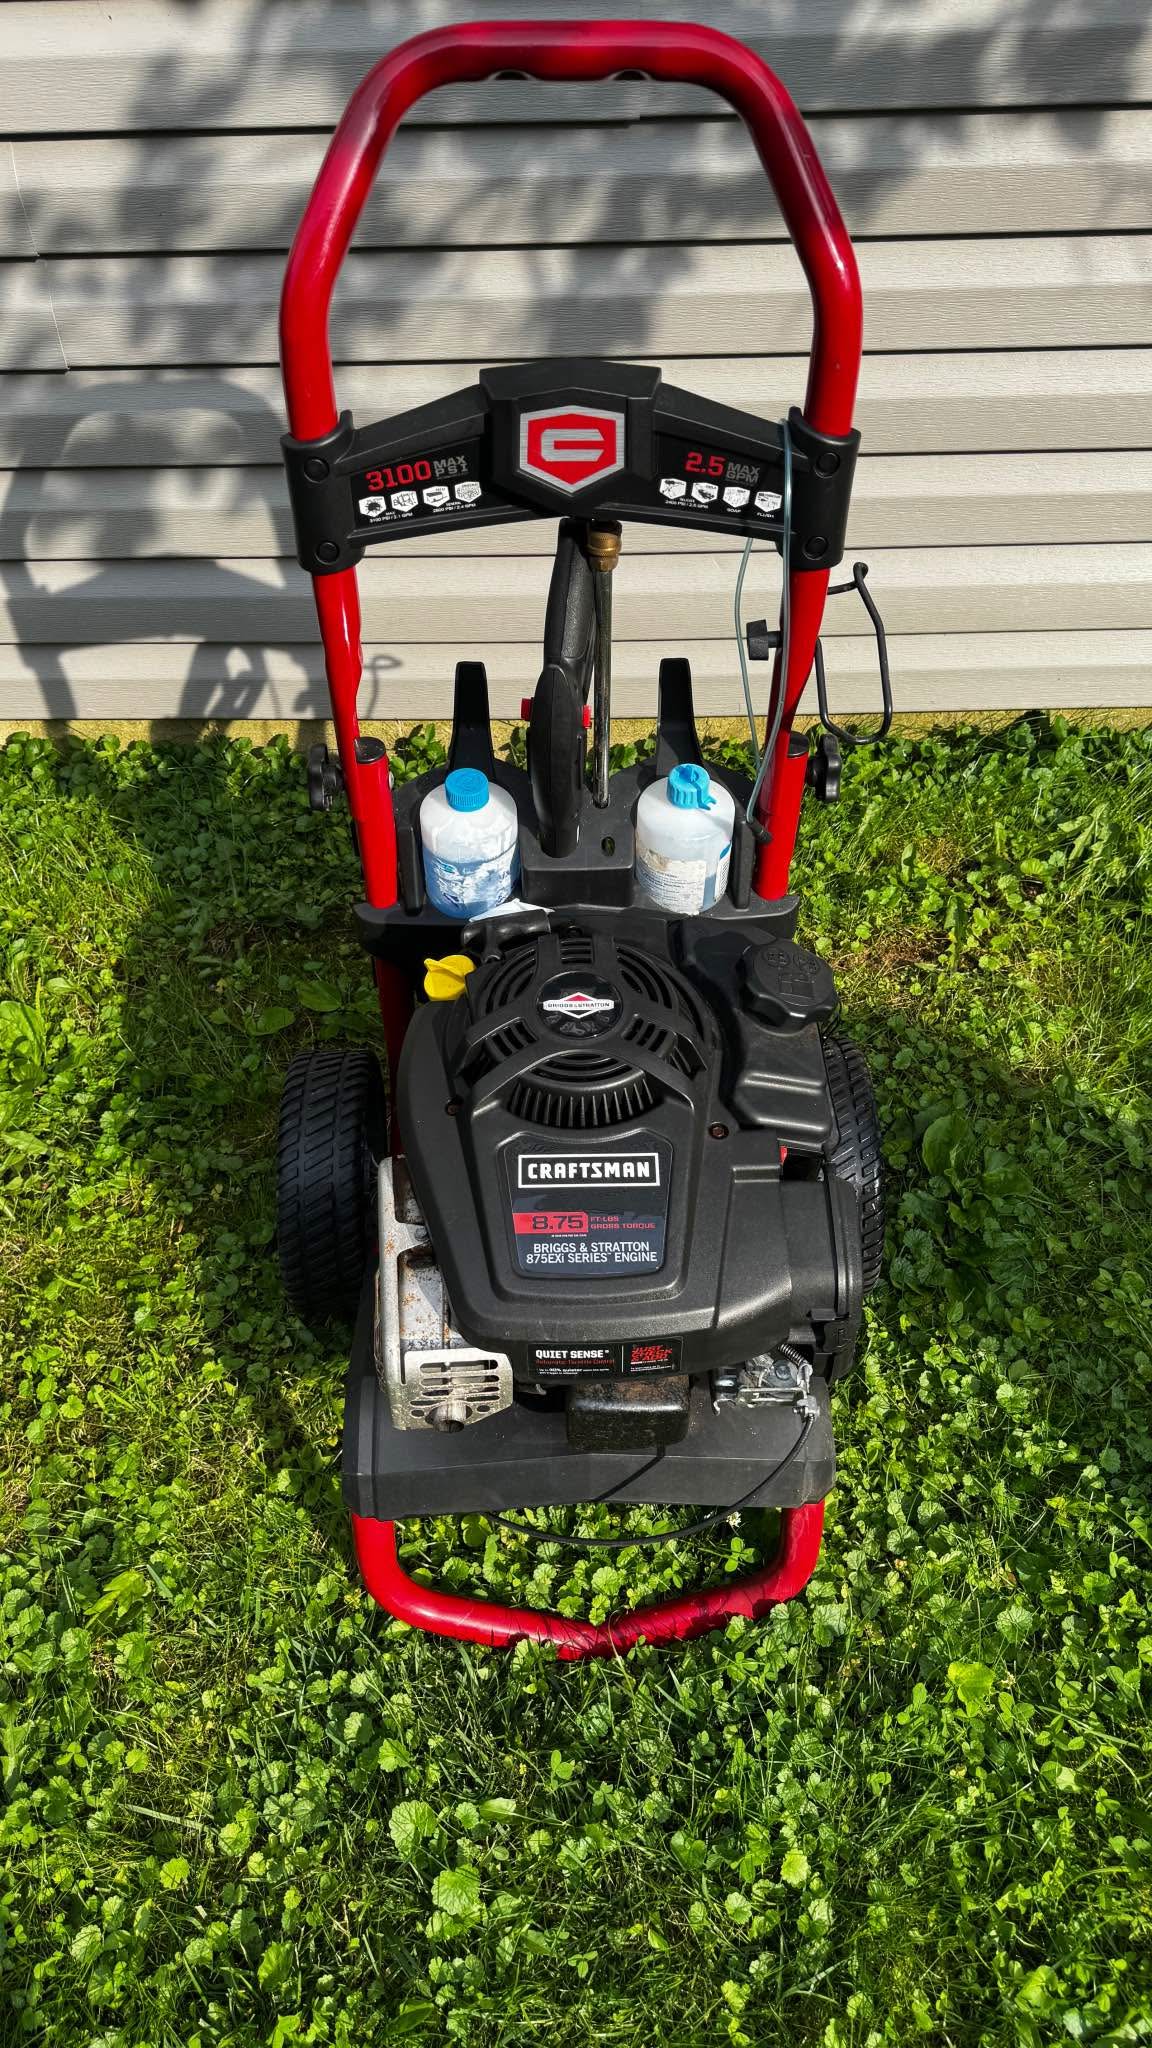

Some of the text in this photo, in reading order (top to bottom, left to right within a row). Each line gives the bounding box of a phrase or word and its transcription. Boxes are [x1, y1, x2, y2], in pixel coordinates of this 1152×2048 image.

[433, 455, 466, 470] MAX
[684, 451, 727, 477] 2.5
[728, 462, 760, 475] MAX
[365, 460, 432, 492] 3100
[435, 464, 469, 477] PSI
[726, 470, 759, 482] GPM
[527, 1161, 650, 1179] CRAFTSMAN
[532, 1215, 584, 1230] 8.75
[533, 1241, 650, 1253] BRIGGS & STRATTON
[526, 1253, 565, 1264] 875EXi
[614, 1252, 658, 1262] ENGINE
[535, 1349, 604, 1359] QUIET SENSE
